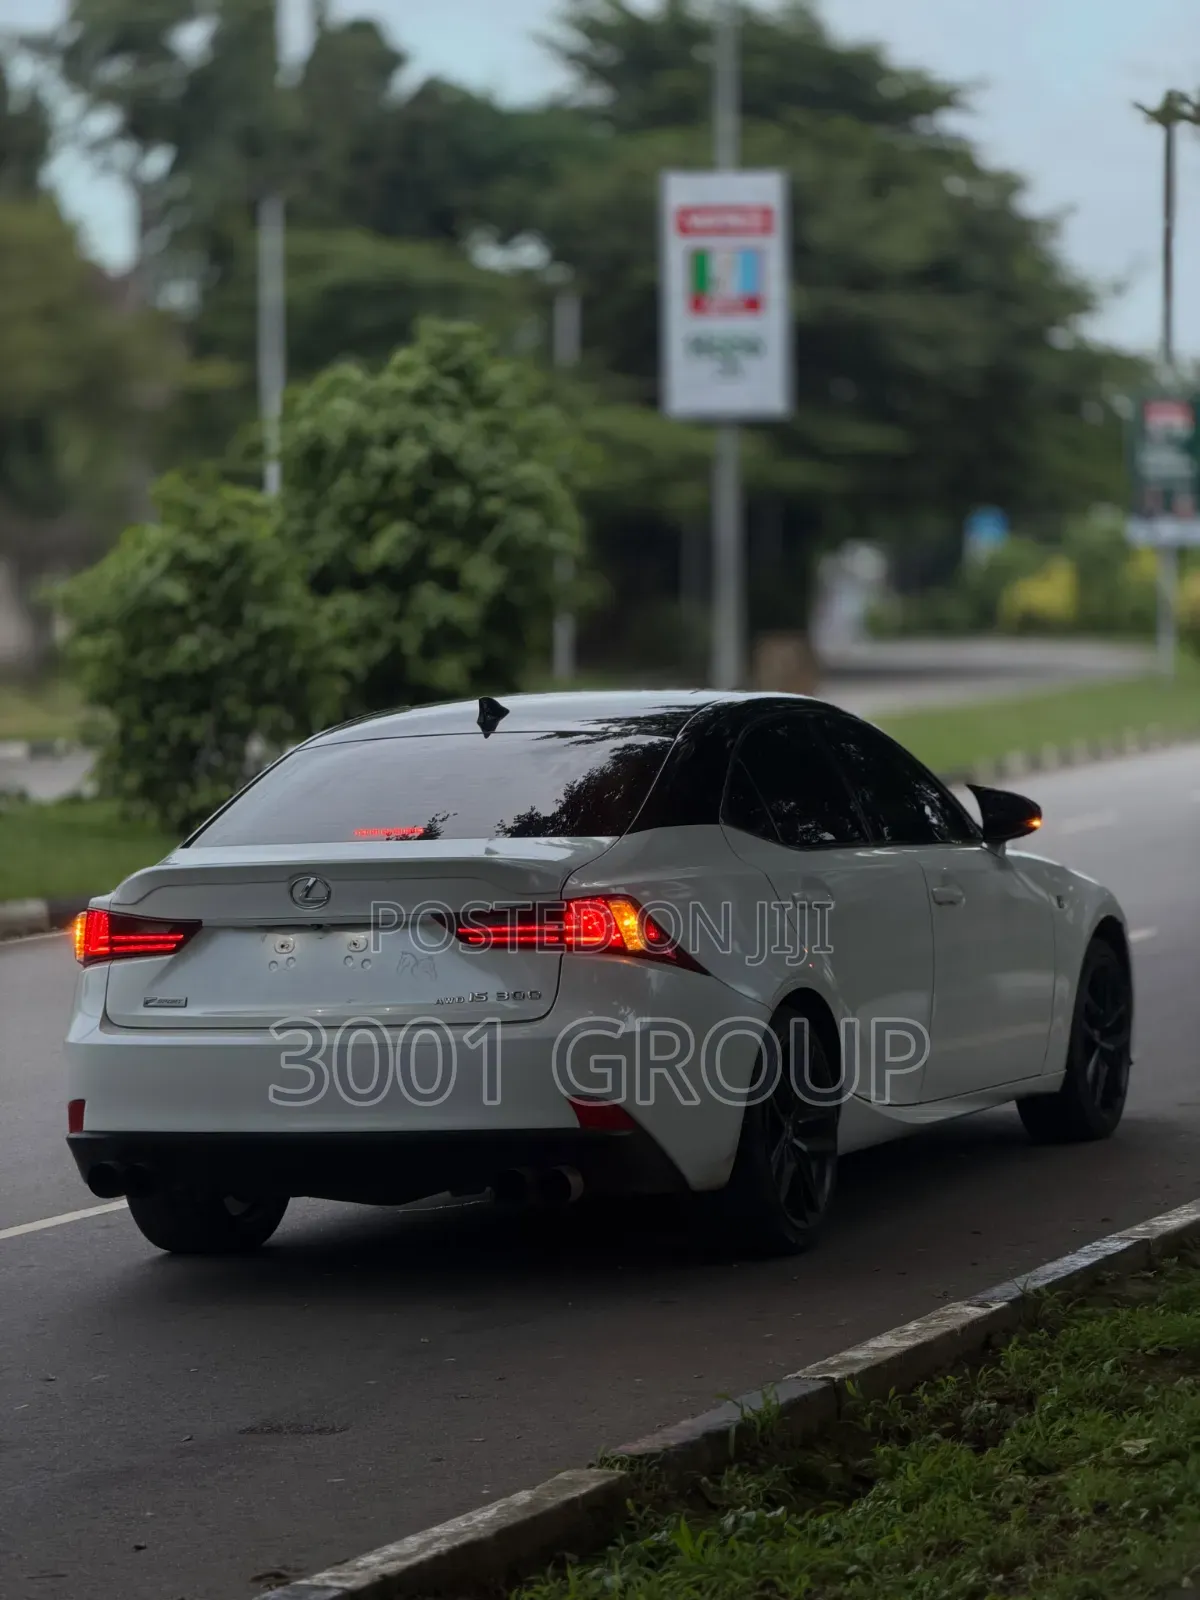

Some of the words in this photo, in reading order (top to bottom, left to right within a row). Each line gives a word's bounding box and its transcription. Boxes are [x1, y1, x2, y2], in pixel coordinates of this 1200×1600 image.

[434, 996, 465, 1006] AWD
[468, 992, 488, 1003] IS
[496, 990, 542, 1001] 300
